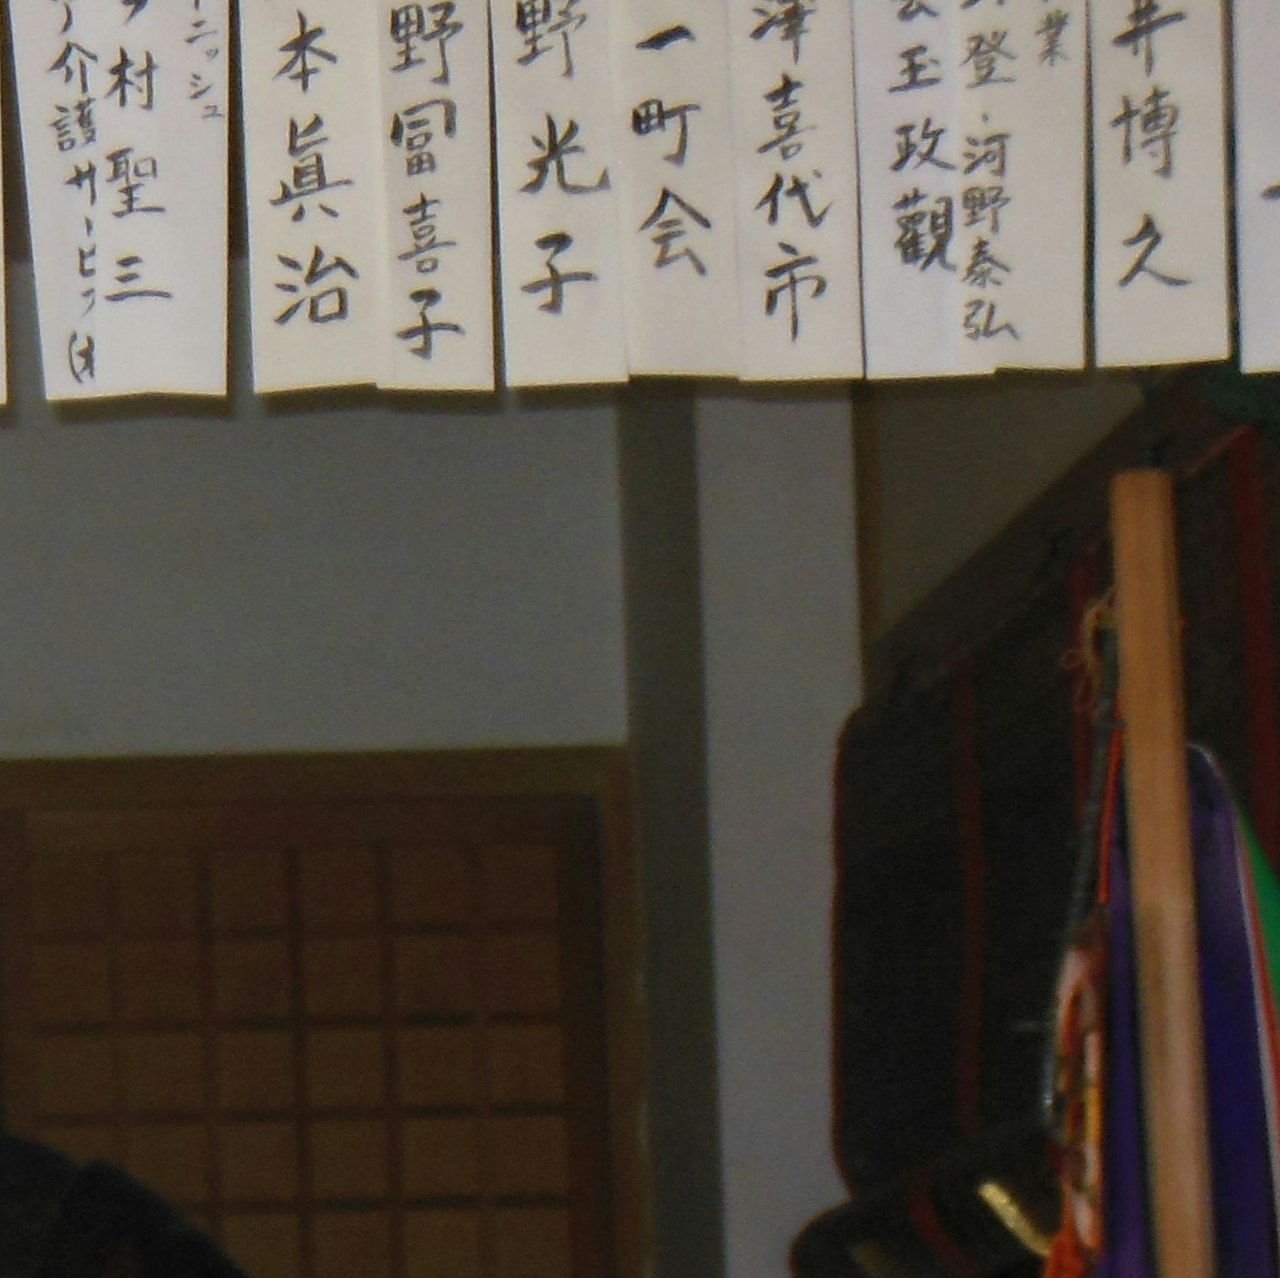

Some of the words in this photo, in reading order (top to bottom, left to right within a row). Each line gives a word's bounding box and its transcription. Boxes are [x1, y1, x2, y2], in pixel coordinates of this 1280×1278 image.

[515, 0, 612, 316] 野光子
[962, 0, 1020, 342] 登・河野泰弘
[1036, 0, 1070, 67] 業
